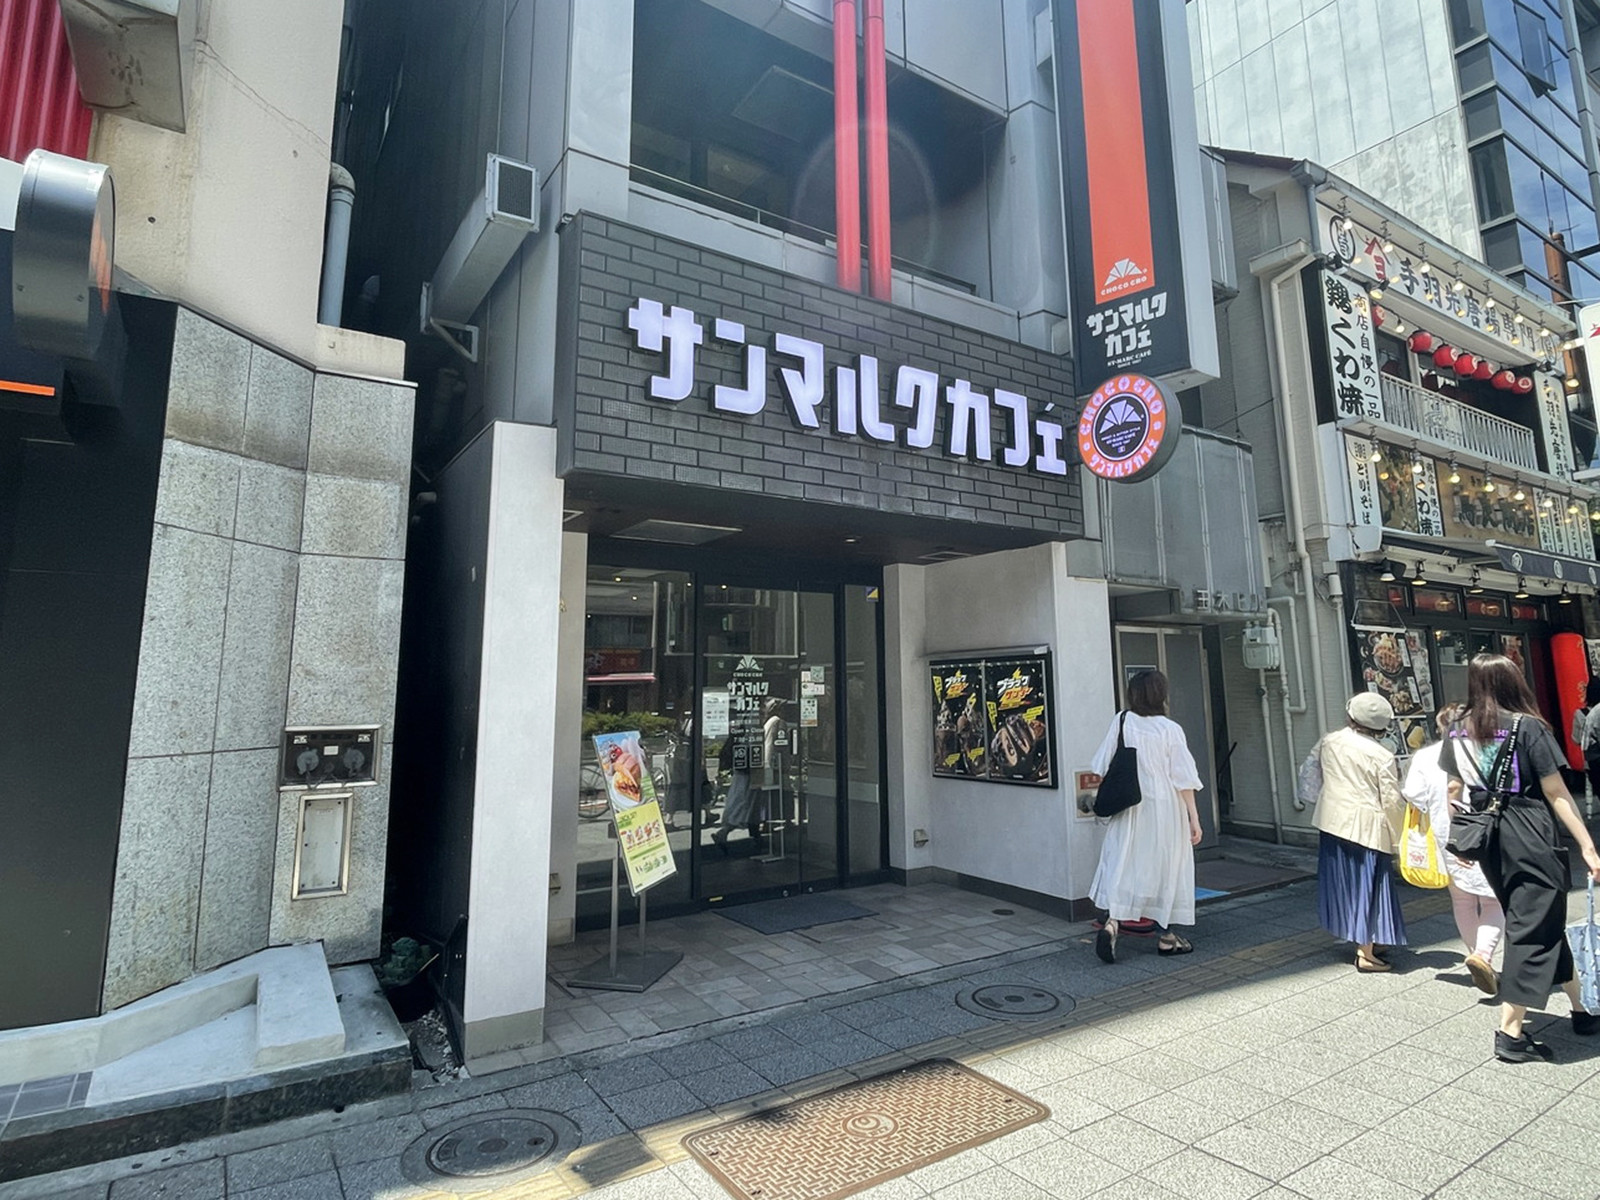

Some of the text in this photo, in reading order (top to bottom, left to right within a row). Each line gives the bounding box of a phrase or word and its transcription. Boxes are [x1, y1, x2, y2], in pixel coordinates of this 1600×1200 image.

[1100, 276, 1147, 296] CHOCO CRO
[1086, 292, 1167, 337] サンマルク
[1105, 324, 1152, 358] カフェ
[627, 297, 1067, 476] サンマルクカフェ
[1079, 376, 1163, 436] CHOCO CRO
[727, 682, 769, 696] サンマルク
[736, 697, 760, 711] カフェ
